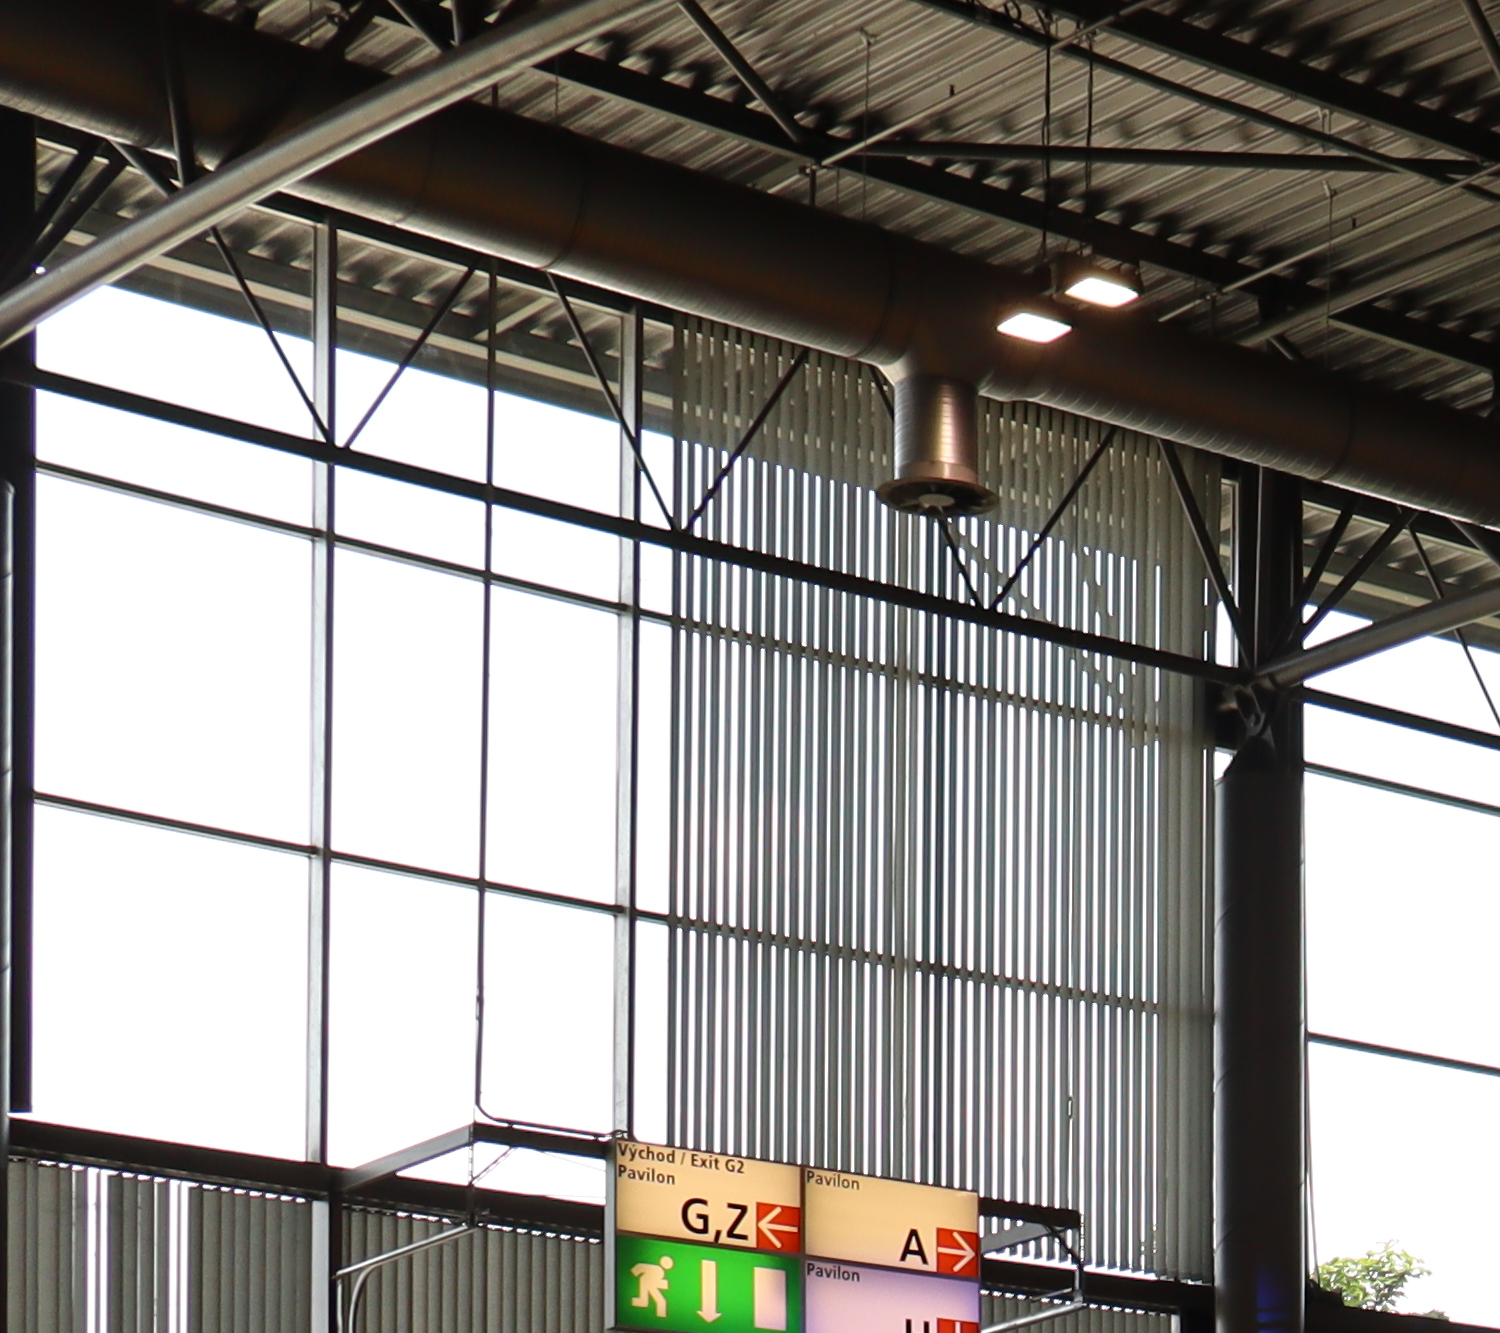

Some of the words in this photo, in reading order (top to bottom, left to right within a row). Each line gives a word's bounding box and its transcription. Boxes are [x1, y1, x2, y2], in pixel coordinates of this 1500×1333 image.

[617, 1142, 676, 1165] Východ
[690, 1153, 720, 1171] Exit
[724, 1158, 745, 1175] G2
[618, 1164, 676, 1186] Pavilon
[806, 1170, 860, 1191] Pavilon
[681, 1197, 749, 1244] G,Z
[899, 1228, 929, 1265] A
[806, 1263, 861, 1283] Pavilon
